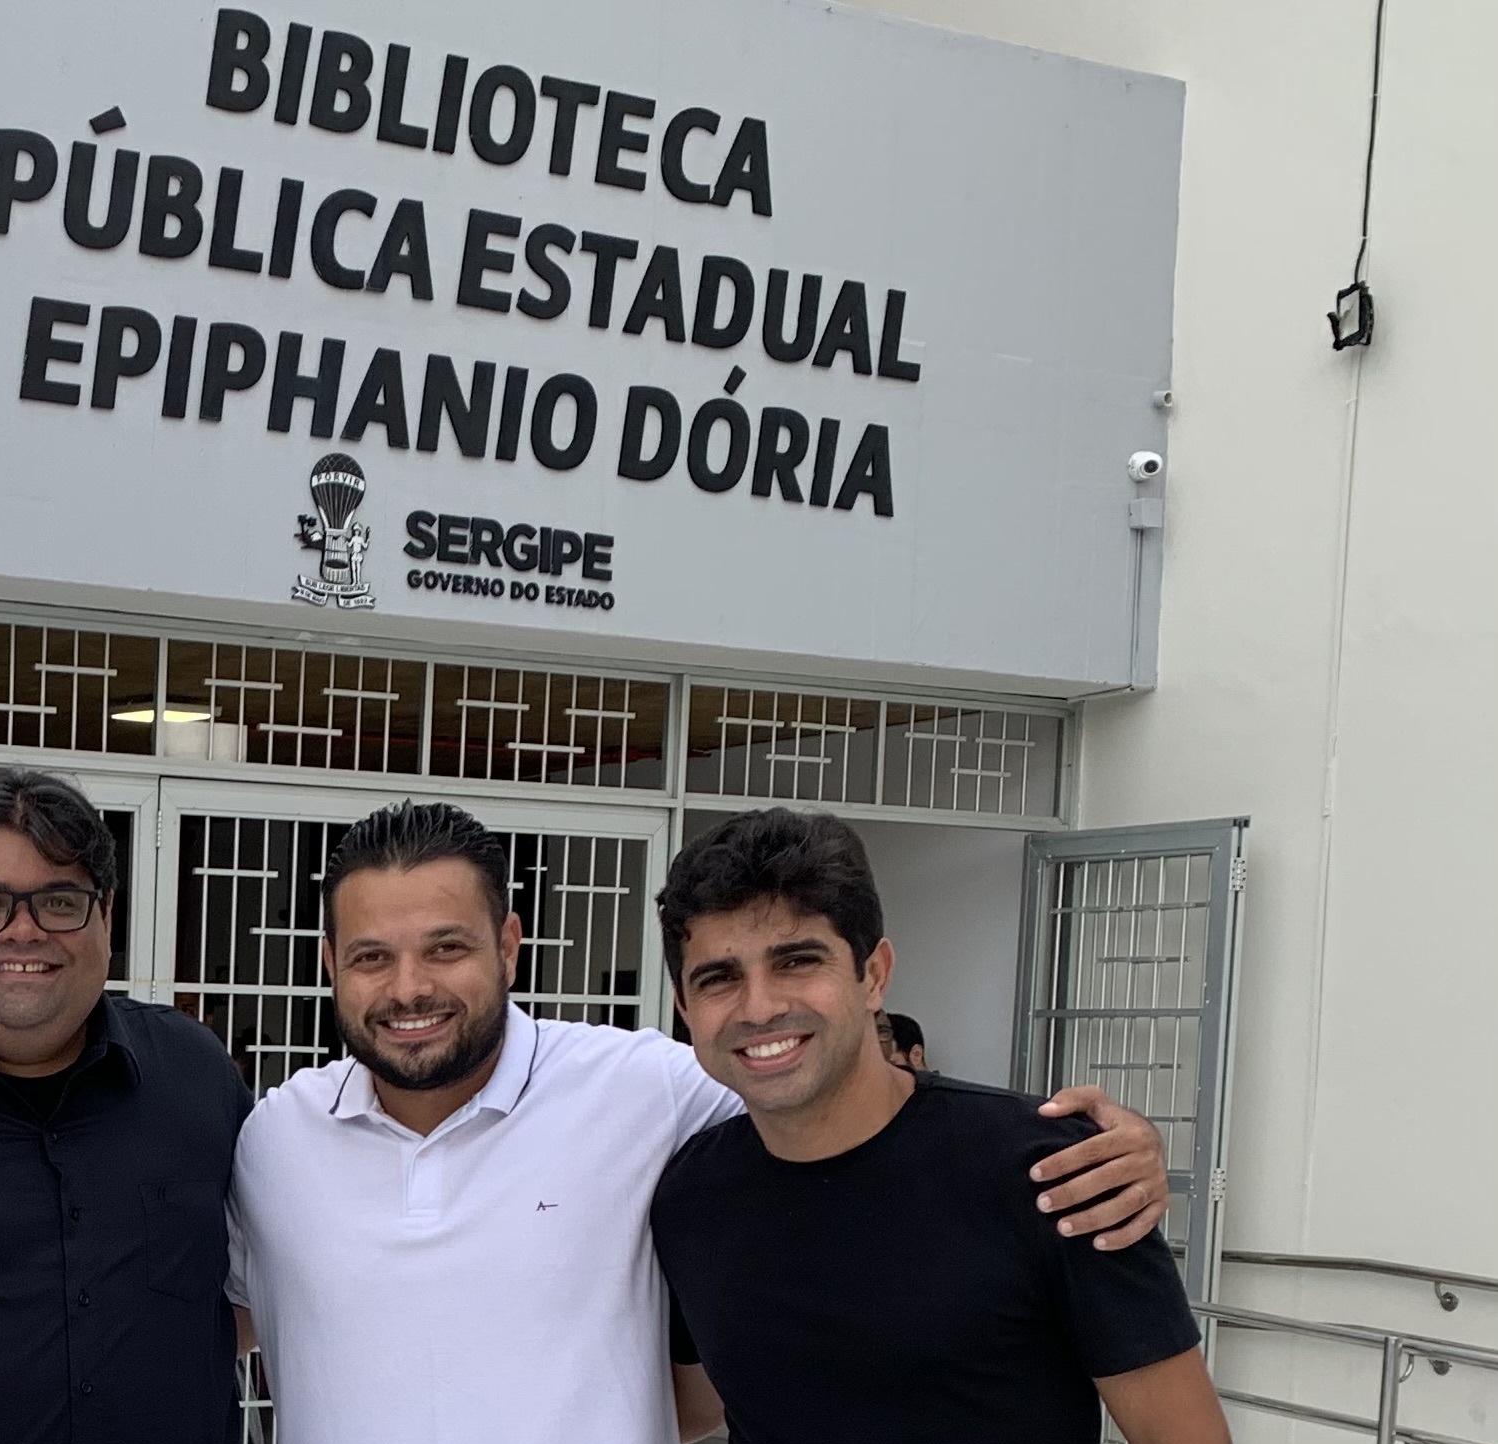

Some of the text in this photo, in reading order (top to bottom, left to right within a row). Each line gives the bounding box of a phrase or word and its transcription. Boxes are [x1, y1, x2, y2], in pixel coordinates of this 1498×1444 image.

[205, 8, 773, 218] BIBLIOTECA
[456, 208, 921, 384] ESTADUAL
[18, 296, 894, 518] EPIPHANIO DÓRIA
[316, 471, 360, 488] PORVIR
[402, 509, 615, 582] SERGIPE
[406, 569, 615, 611] GOVERNO DO ESTADO
